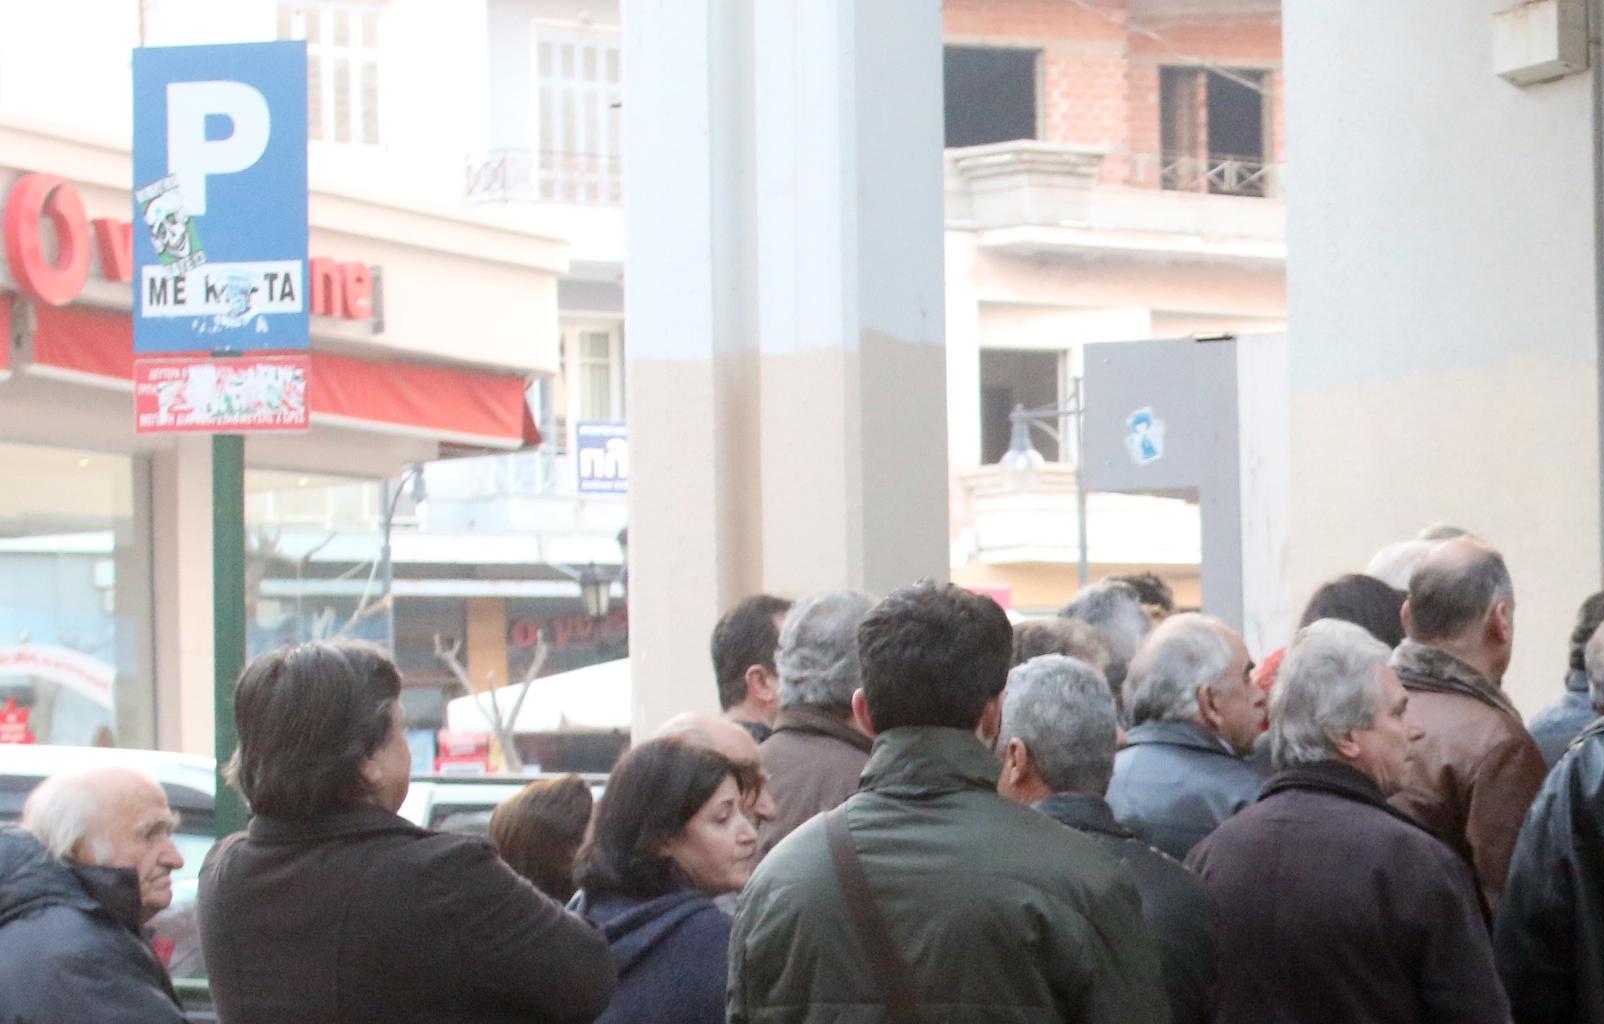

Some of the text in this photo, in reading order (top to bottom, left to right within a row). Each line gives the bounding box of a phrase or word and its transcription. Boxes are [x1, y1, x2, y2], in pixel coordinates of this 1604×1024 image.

[166, 80, 271, 216] P
[149, 272, 296, 306] ΜΕ ΚΤΑ
